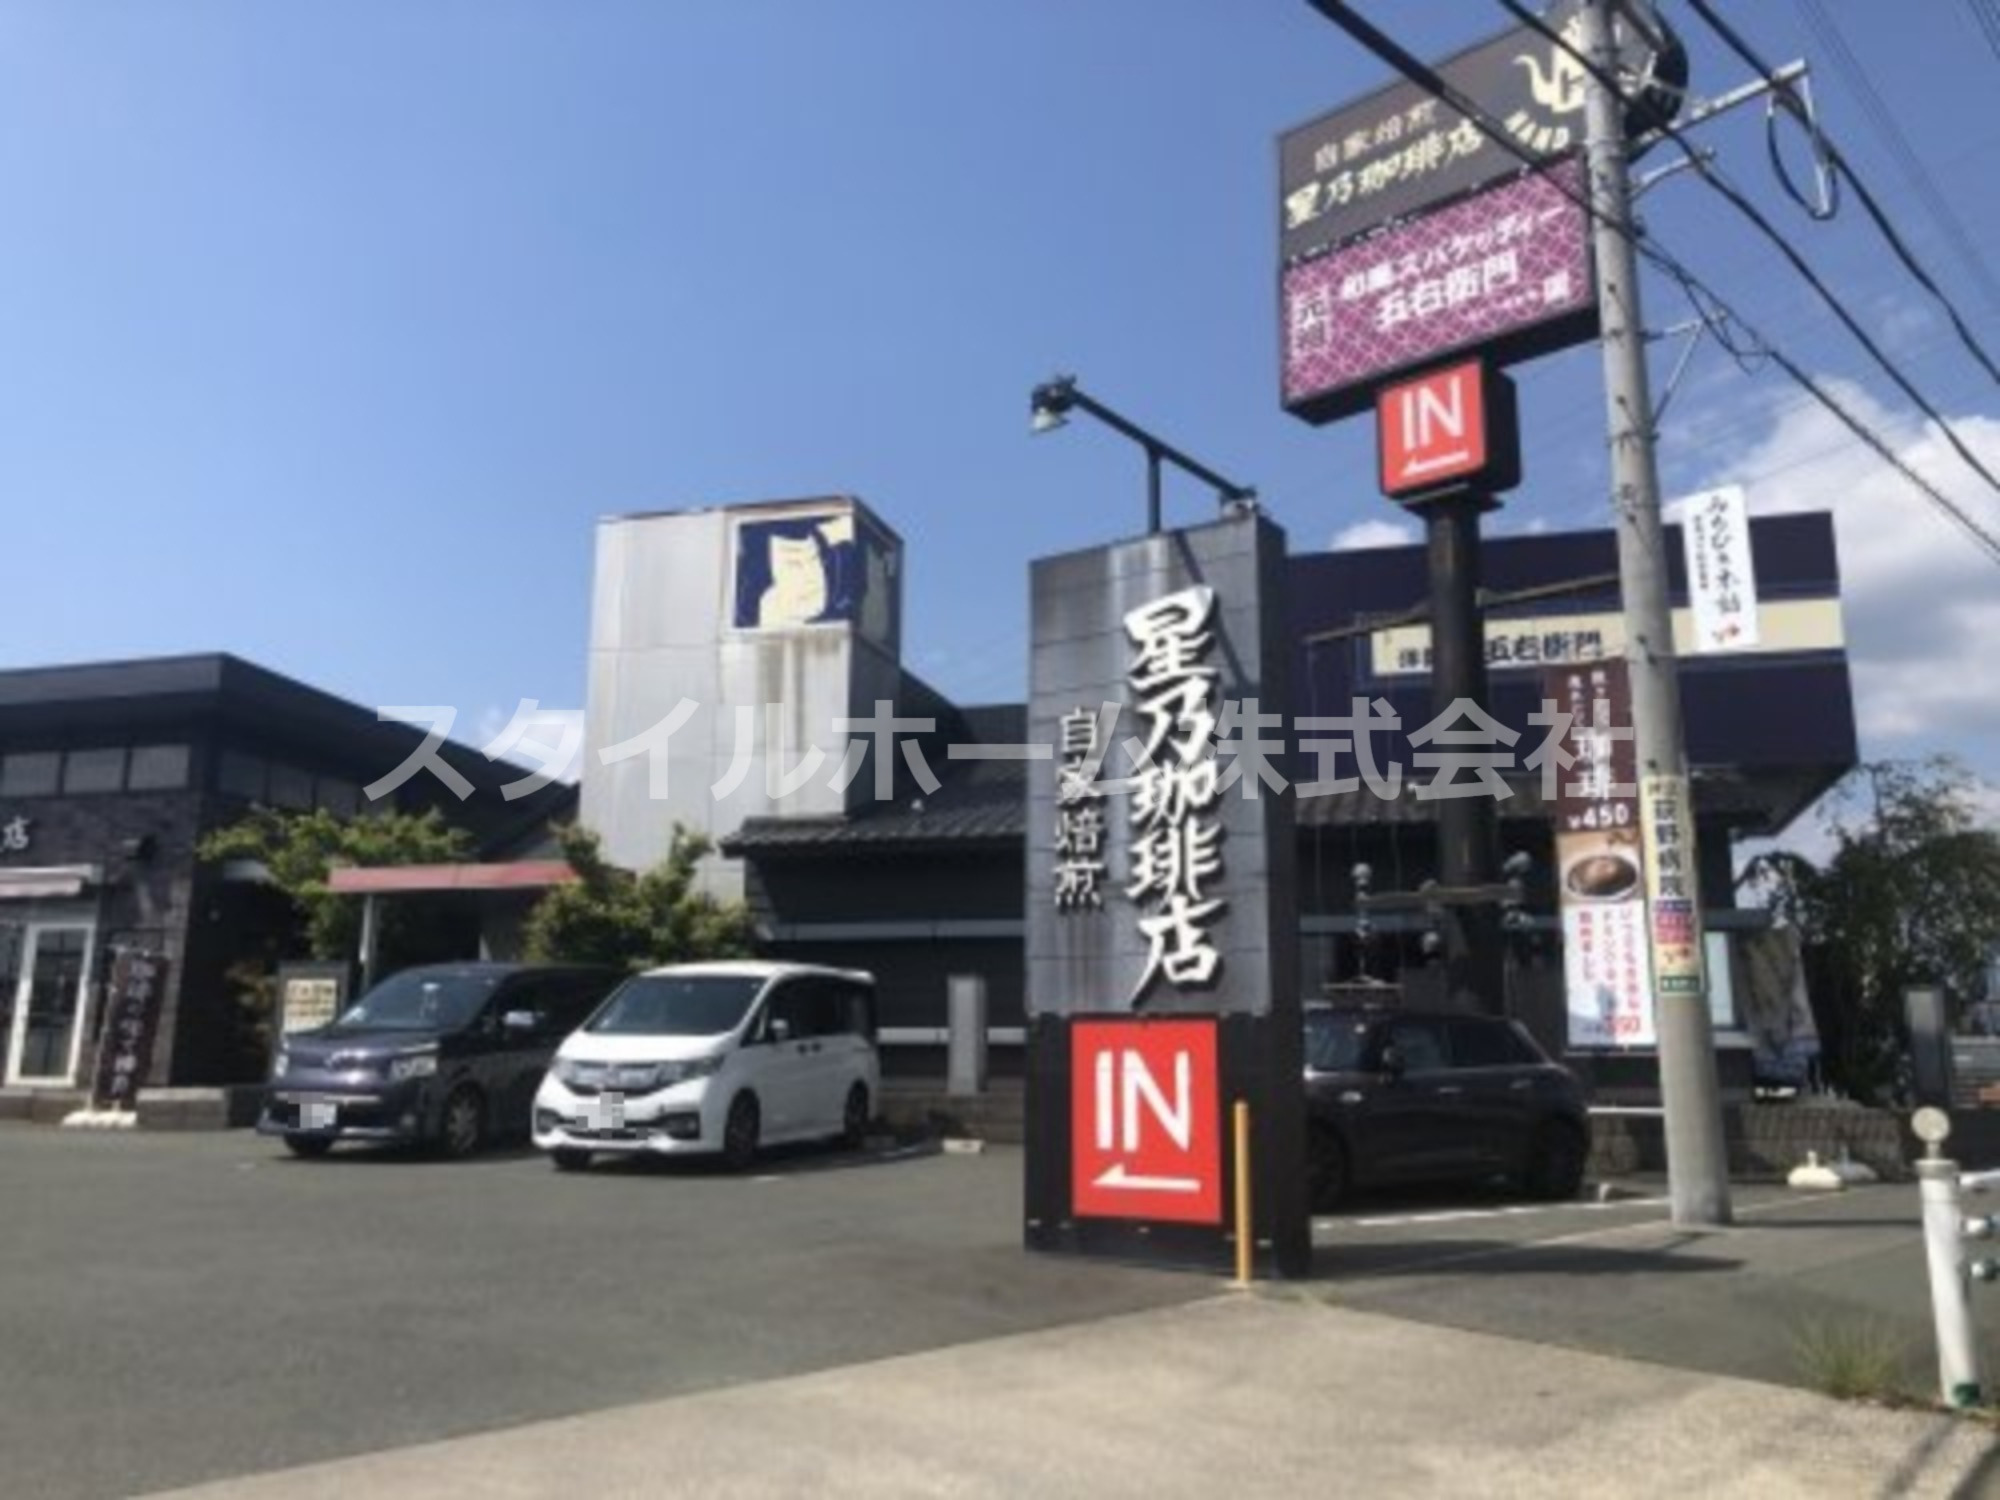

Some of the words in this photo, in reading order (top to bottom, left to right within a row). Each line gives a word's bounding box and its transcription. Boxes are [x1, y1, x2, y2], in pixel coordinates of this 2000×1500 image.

[1284, 117, 1484, 231] 星乃珈琲店
[1375, 249, 1519, 333] 五右衛門
[1402, 374, 1465, 451] IN
[1054, 705, 1104, 906] 自家焙煎
[1123, 586, 1222, 1000] 星乃珈琲店
[1095, 1049, 1191, 1152] IN
